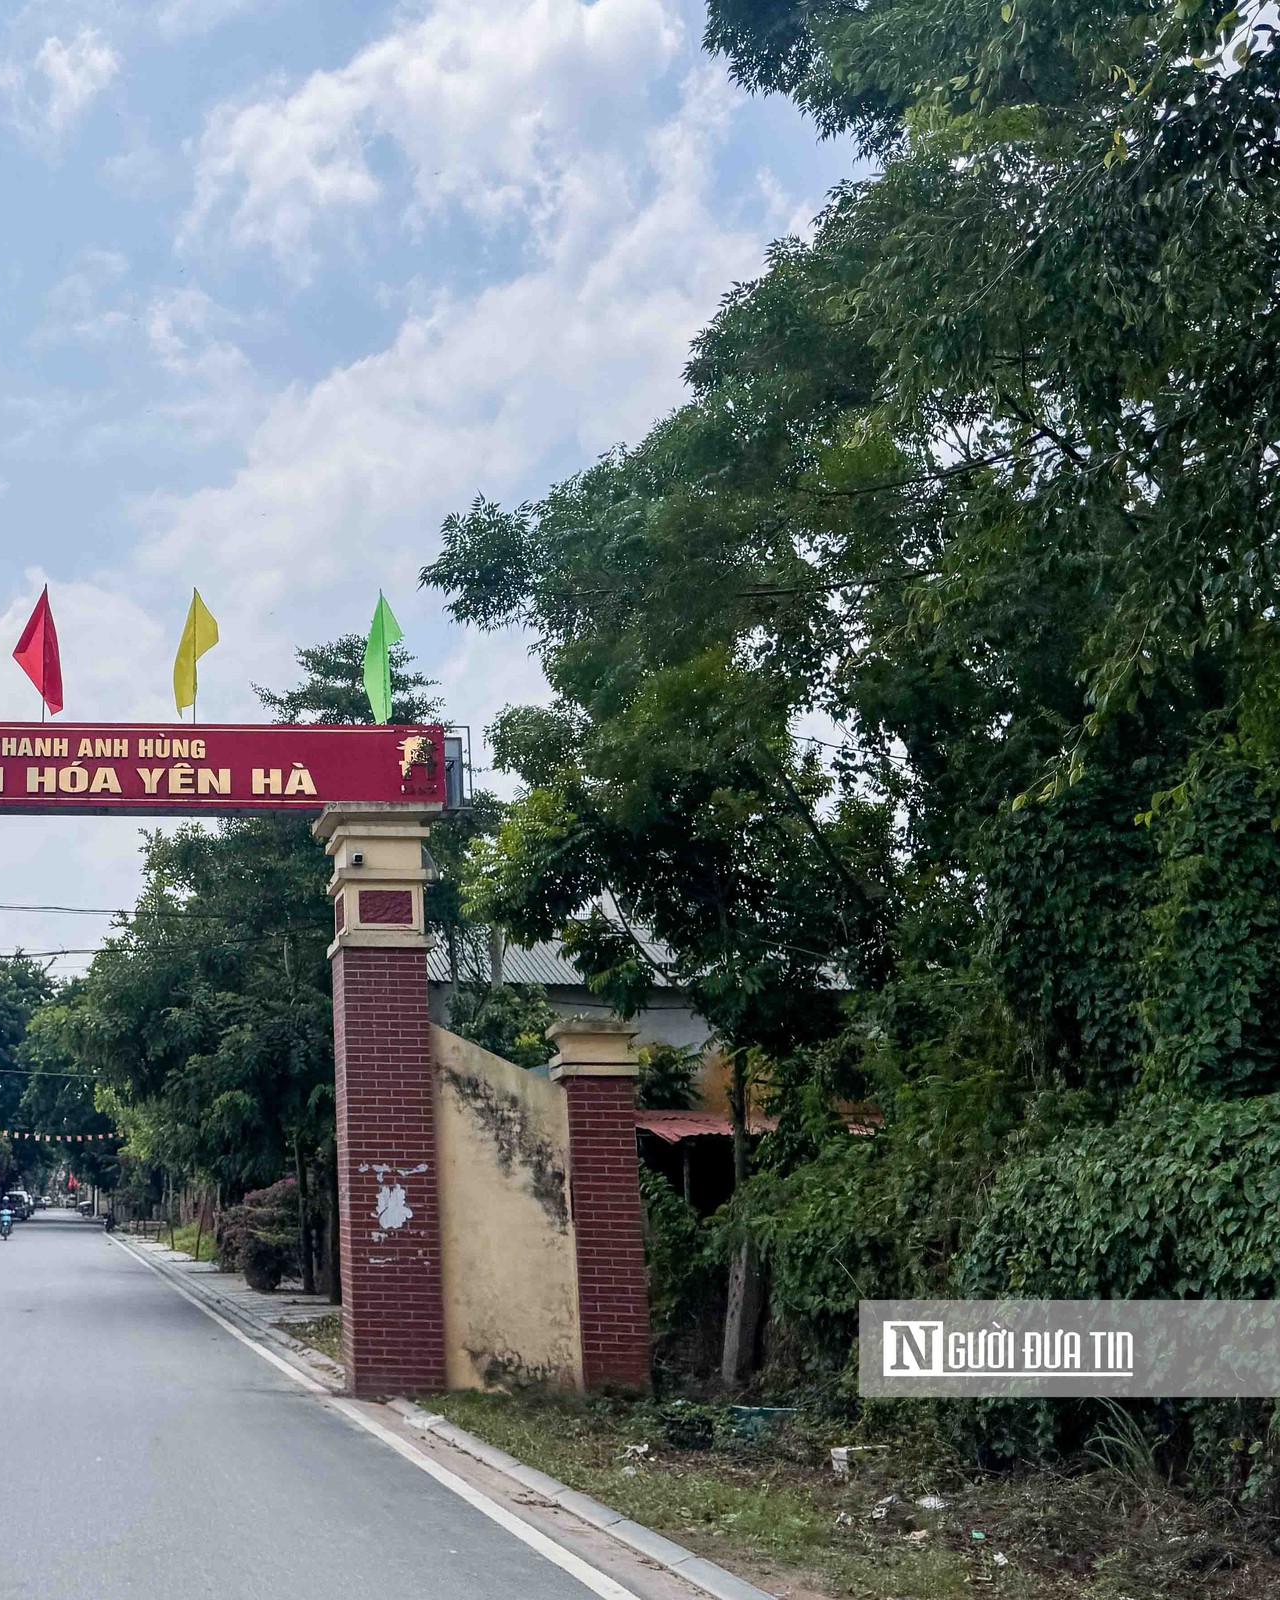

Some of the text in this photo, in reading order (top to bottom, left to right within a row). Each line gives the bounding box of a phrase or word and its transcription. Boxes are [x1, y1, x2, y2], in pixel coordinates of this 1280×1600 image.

[77, 738, 129, 758] ANH
[138, 733, 206, 759] HÙNG
[26, 760, 123, 793] HÓA
[136, 762, 231, 794] YÊN
[252, 762, 318, 795] HÀ
